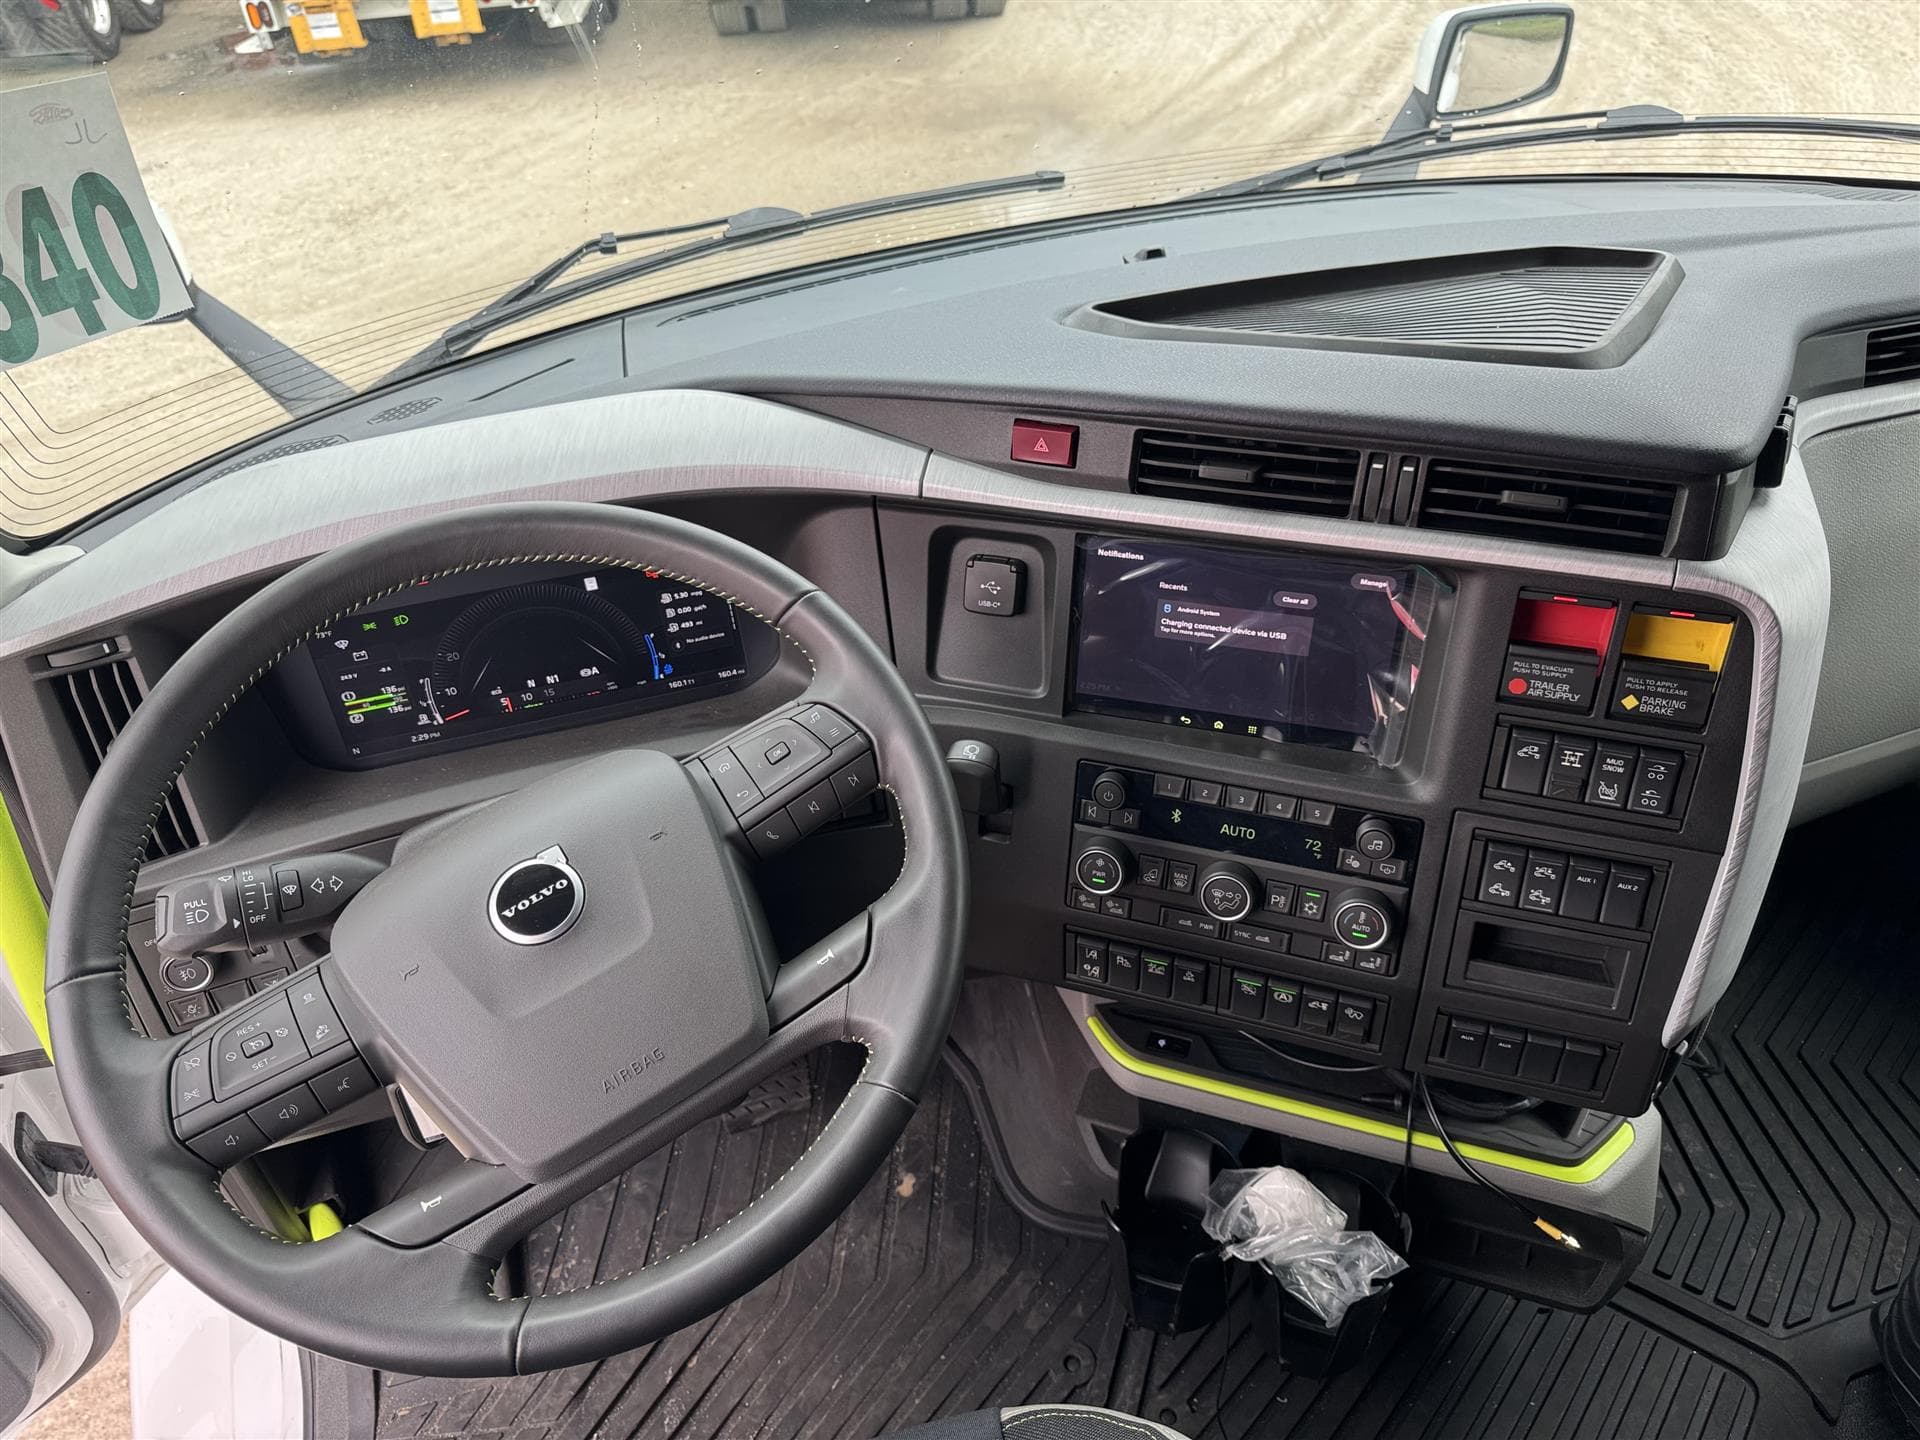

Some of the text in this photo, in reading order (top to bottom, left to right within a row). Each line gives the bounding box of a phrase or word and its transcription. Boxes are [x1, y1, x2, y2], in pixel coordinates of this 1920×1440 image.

[1098, 548, 1144, 561] Notifications
[1159, 581, 1188, 592] Recents
[1360, 578, 1388, 588] Manage
[1282, 596, 1299, 604] Clear
[1177, 606, 1220, 617] Android System
[1160, 626, 1170, 634] Tap
[1161, 618, 1287, 640] Charging connected device via USB
[447, 652, 460, 662] 20
[1541, 664, 1574, 674] EVACUATE
[1542, 670, 1568, 678] SUPPLY
[527, 679, 536, 688] N
[1529, 680, 1570, 693] TRAILER
[1656, 680, 1678, 688] APPLY
[380, 685, 398, 694] 136
[445, 686, 458, 696] 10
[1626, 682, 1646, 690] PUSH
[1657, 686, 1688, 696] RELEASE
[520, 692, 534, 702] 10
[544, 688, 556, 697] 15
[1526, 688, 1581, 702] AIR SUPPLY
[1641, 696, 1688, 710] PARKING
[1639, 703, 1675, 716] BRAKE
[1606, 758, 1624, 766] MUD
[1602, 764, 1624, 773] SNOW
[1202, 788, 1208, 797] 2
[1238, 795, 1246, 804] 3
[1276, 802, 1282, 810] 4
[1314, 809, 1321, 818] 5
[1220, 823, 1256, 840] AUTO
[1304, 838, 1322, 852] 72
[1174, 872, 1188, 880] MAX
[1576, 875, 1591, 884] AUX
[1617, 882, 1631, 891] AUX
[501, 878, 568, 918] VOLVO
[184, 899, 208, 910] PULL
[250, 914, 266, 924] OFF
[1351, 923, 1371, 933] AUTO
[1234, 930, 1252, 939] SYNC
[236, 1025, 254, 1037] RES
[252, 1058, 269, 1071] SET
[601, 1048, 665, 1094] AIRBAG
